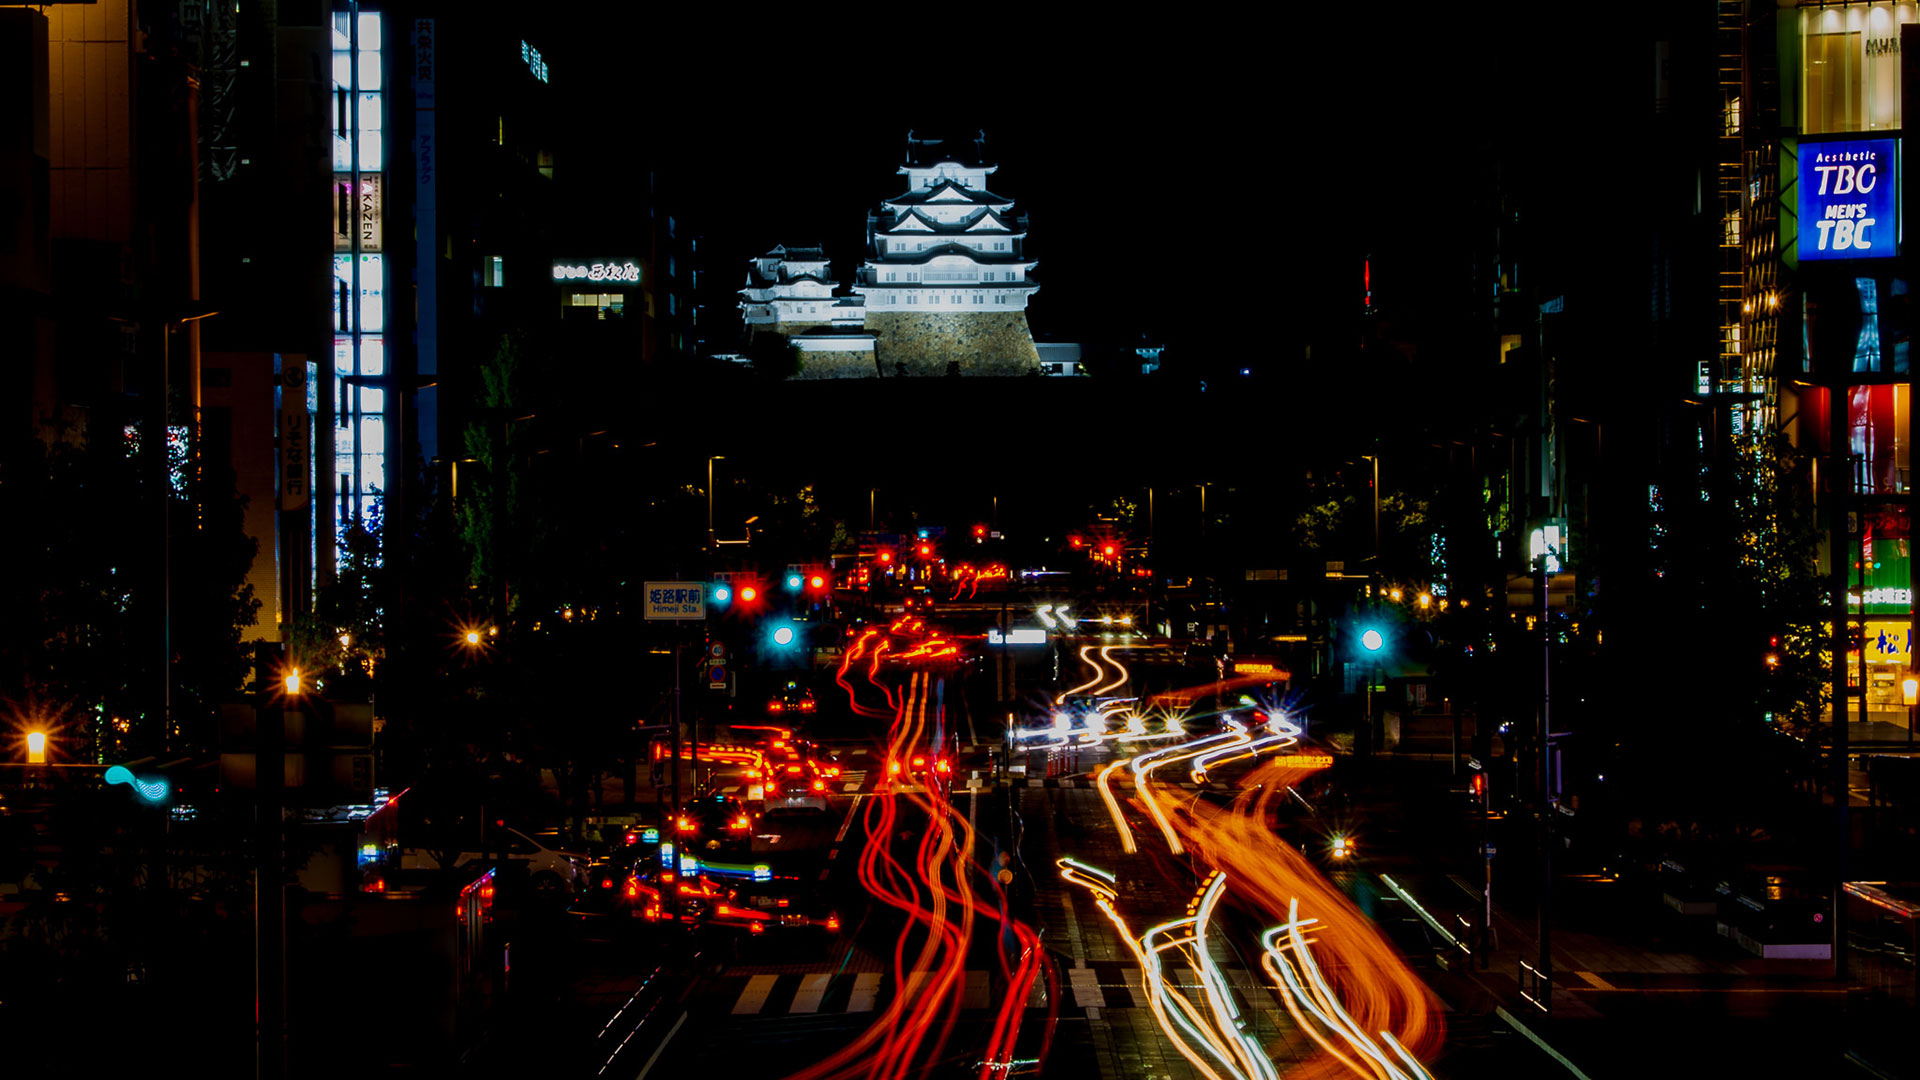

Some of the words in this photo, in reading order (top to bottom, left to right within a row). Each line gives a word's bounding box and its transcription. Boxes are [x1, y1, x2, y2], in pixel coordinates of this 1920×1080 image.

[1816, 151, 1876, 163] Aesthetic
[1814, 163, 1877, 195] TBC
[362, 176, 373, 240] TAKAZEN
[1825, 203, 1867, 219] MEN'S
[1816, 218, 1875, 250] TBC
[286, 415, 303, 496] りそな銀行
[649, 589, 701, 604] 姫路駅前
[653, 604, 679, 615] Himeji
[682, 604, 699, 613] Sta.
[1876, 629, 1912, 654] 松
